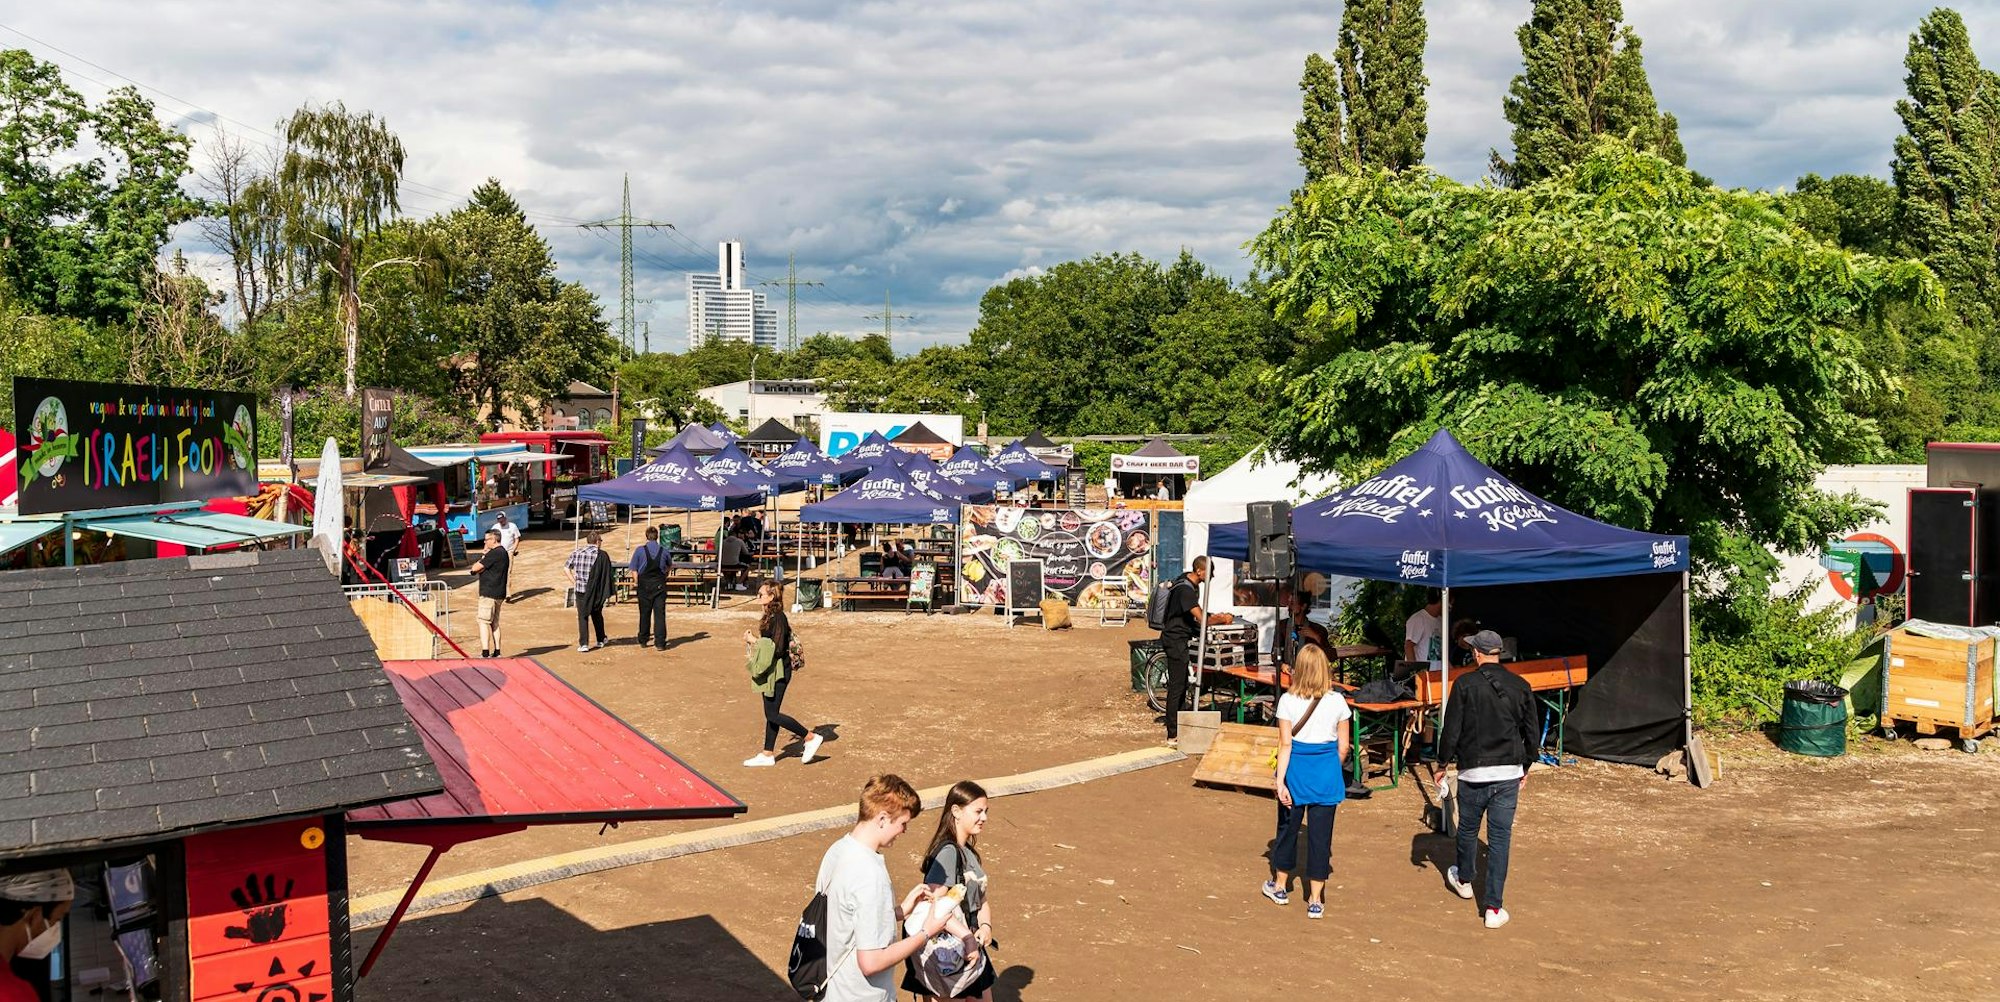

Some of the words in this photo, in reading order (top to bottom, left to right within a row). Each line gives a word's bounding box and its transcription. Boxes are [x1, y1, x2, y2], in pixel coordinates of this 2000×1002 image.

[90, 401, 116, 423] vegan
[119, 397, 126, 416] &
[128, 396, 169, 424] vegetarian
[171, 397, 199, 425] healthy
[199, 399, 216, 425] food
[84, 428, 169, 490] ISRAELI
[177, 428, 224, 490] FOOD
[947, 460, 979, 471] Gaffel
[645, 462, 689, 477] Gaffel
[862, 478, 905, 493] Gaffel
[1351, 474, 1435, 508] Gaffel
[1450, 477, 1537, 510] Gaffel
[857, 488, 904, 500] Kölsch
[1320, 497, 1407, 524] Kölsch
[1479, 503, 1558, 532] Kölsch
[1652, 540, 1676, 555] Gaffel
[1402, 550, 1429, 565] Gaffel
[1400, 563, 1428, 579] Kölsch
